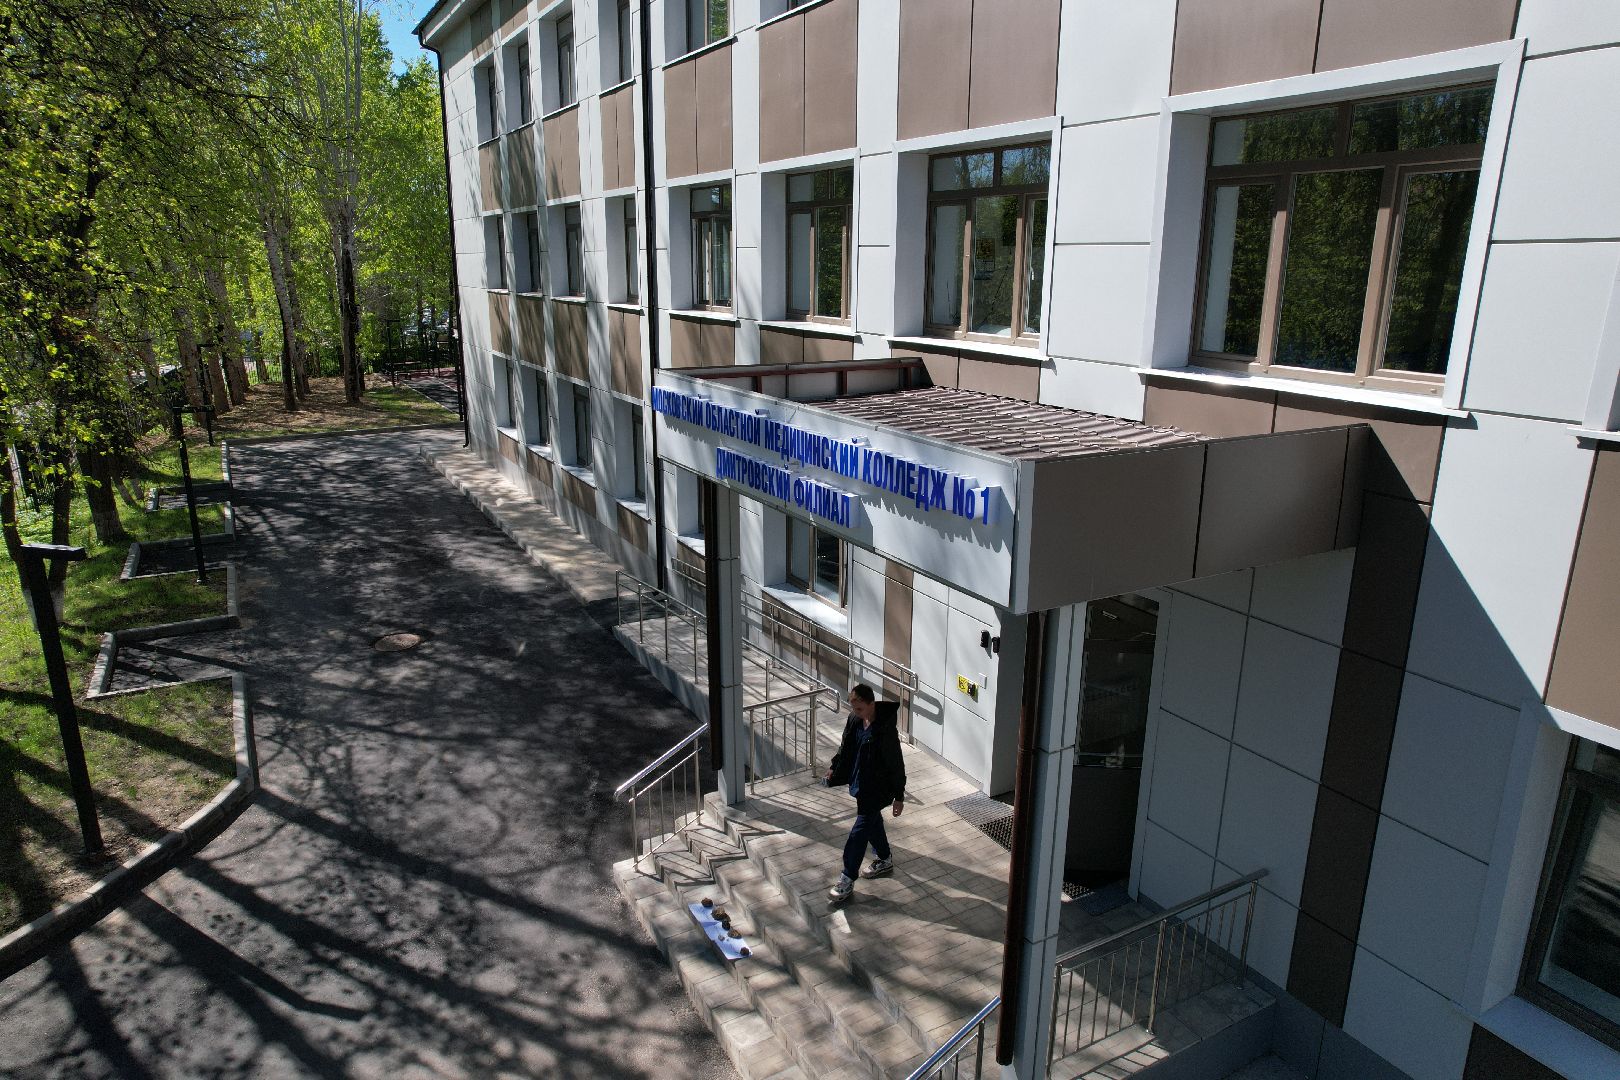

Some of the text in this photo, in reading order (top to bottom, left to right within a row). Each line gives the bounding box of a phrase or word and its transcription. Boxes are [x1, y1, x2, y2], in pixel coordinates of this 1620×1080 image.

[706, 401, 760, 446] ОБЛАСТНОЙ
[764, 419, 858, 480] МЕДИЦИНСКИЙ
[862, 448, 948, 512] КОЛЛЕДЖ
[716, 447, 850, 528] ДМИТРОВСКИЙ ФИЛИАЛ
